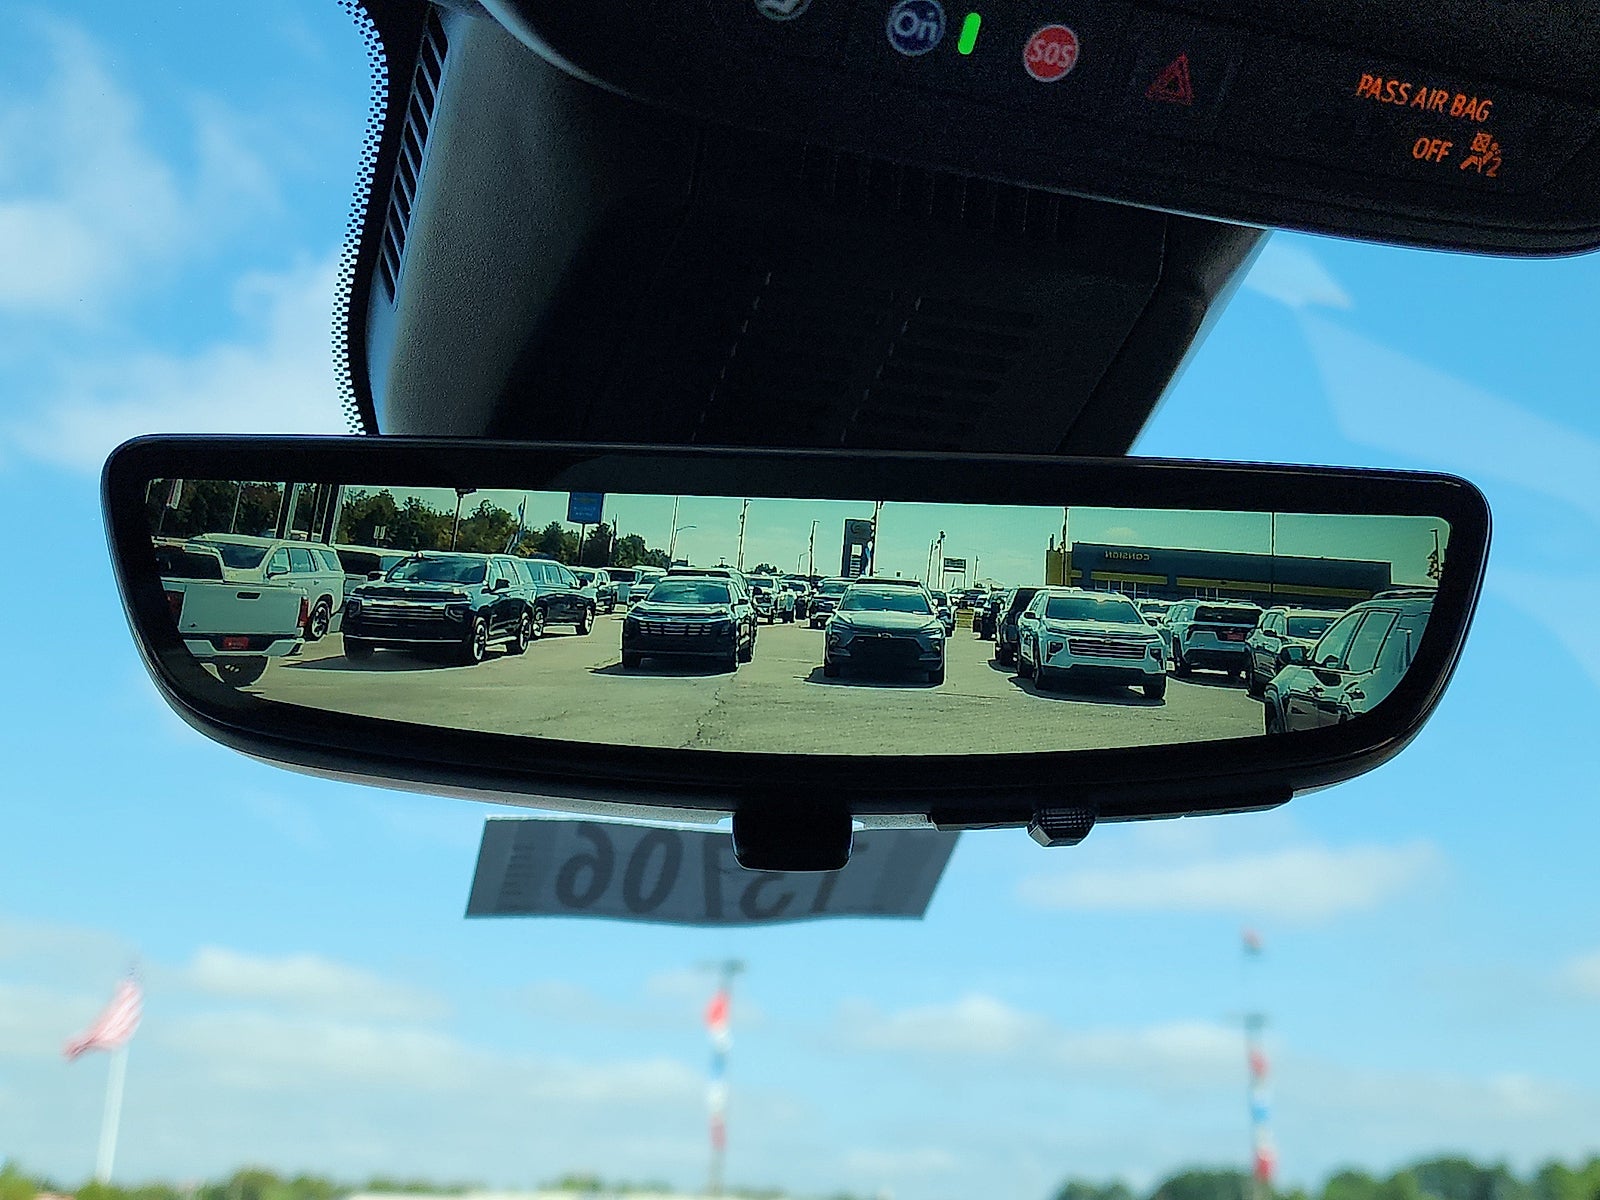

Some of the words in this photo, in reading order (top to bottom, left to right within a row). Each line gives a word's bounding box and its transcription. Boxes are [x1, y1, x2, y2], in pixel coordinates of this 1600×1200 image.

[1027, 38, 1075, 67] SOS
[1355, 73, 1412, 105] PASS
[1410, 87, 1449, 114] AIR
[1449, 93, 1493, 122] BAG
[1412, 137, 1453, 163] OFF
